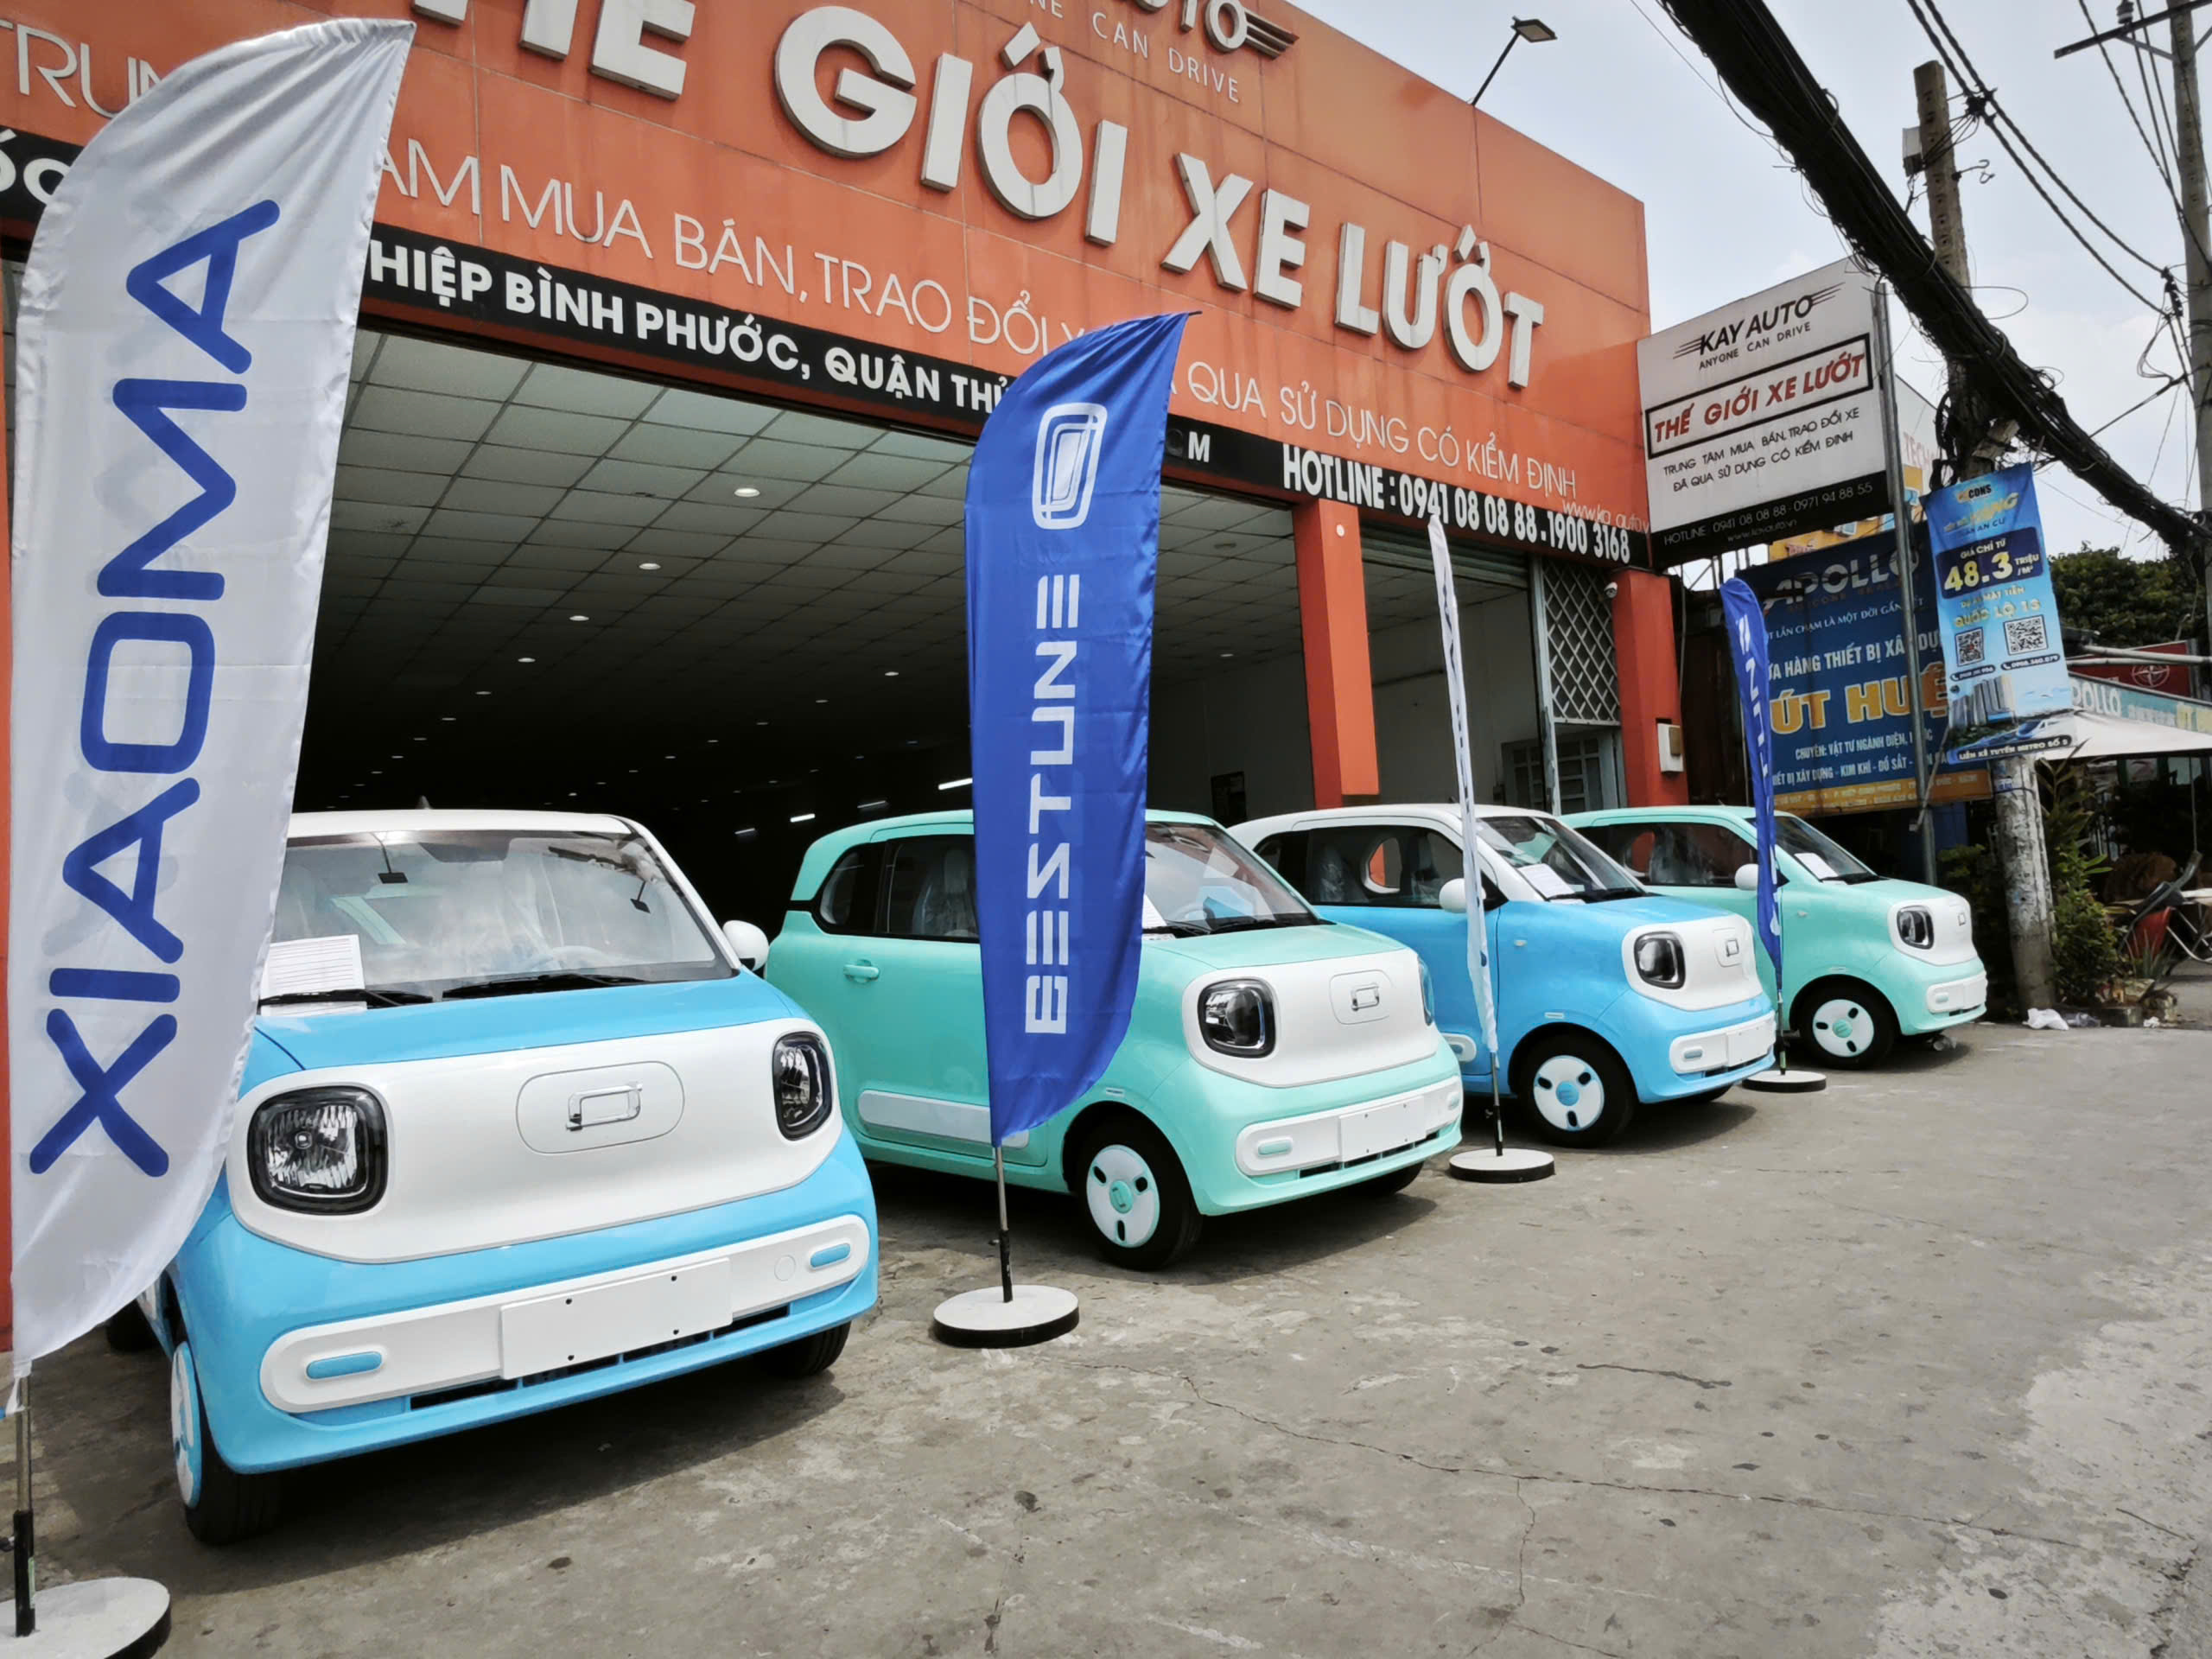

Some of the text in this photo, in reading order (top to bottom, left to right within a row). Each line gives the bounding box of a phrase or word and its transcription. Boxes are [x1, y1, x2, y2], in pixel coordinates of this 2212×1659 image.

[1092, 12, 1148, 59] CAN
[1168, 48, 1239, 103] DRIVE
[774, 5, 1128, 247] GIỚI
[1160, 151, 1310, 309] XE
[1335, 222, 1545, 390] LƯỚT
[370, 238, 493, 308] HIỆP
[505, 266, 624, 334] BÌNH
[824, 346, 941, 402] QUẬN
[500, 164, 653, 259] MUA
[814, 251, 952, 334] TRAO
[967, 289, 1048, 355] ĐỔI
[1187, 361, 1268, 418] QUA
[1280, 380, 1317, 430] SỬ
[1325, 399, 1410, 454] DỤNG
[1417, 425, 1460, 467] CÓ
[1465, 431, 1519, 485] KIỂM
[1699, 294, 1815, 356] KAY AUTO
[1699, 321, 1811, 371] ANYONE CAN DRIVE
[1654, 351, 1866, 443] THẾ GIỚI XE LƯỚT
[1663, 458, 1697, 477] TRUNG
[1730, 441, 1755, 456] MUA
[1789, 420, 1818, 438] TRAO
[1845, 406, 1860, 422] XE
[1399, 474, 1449, 524] 0941
[1454, 487, 1480, 531] 08
[1484, 495, 1510, 537] 08
[1592, 522, 1630, 564] 3168
[1663, 524, 1707, 546] HOTLINE
[1738, 512, 1752, 526] 08
[1756, 508, 1770, 522] 08
[1773, 504, 1787, 518] 88
[1793, 496, 1819, 512] 0971
[1839, 486, 1853, 499] 88
[1858, 482, 1873, 496] 55
[1690, 472, 1714, 486] QUA
[1944, 551, 2013, 591] 48.3
[29, 199, 280, 1177] XIAOMA
[1784, 652, 1821, 678] HÀNG
[1824, 642, 1862, 670] THIẾT
[1866, 639, 1882, 664] BỊ
[1885, 636, 1905, 658] XÂ
[1025, 574, 1080, 1034] BESTUNE
